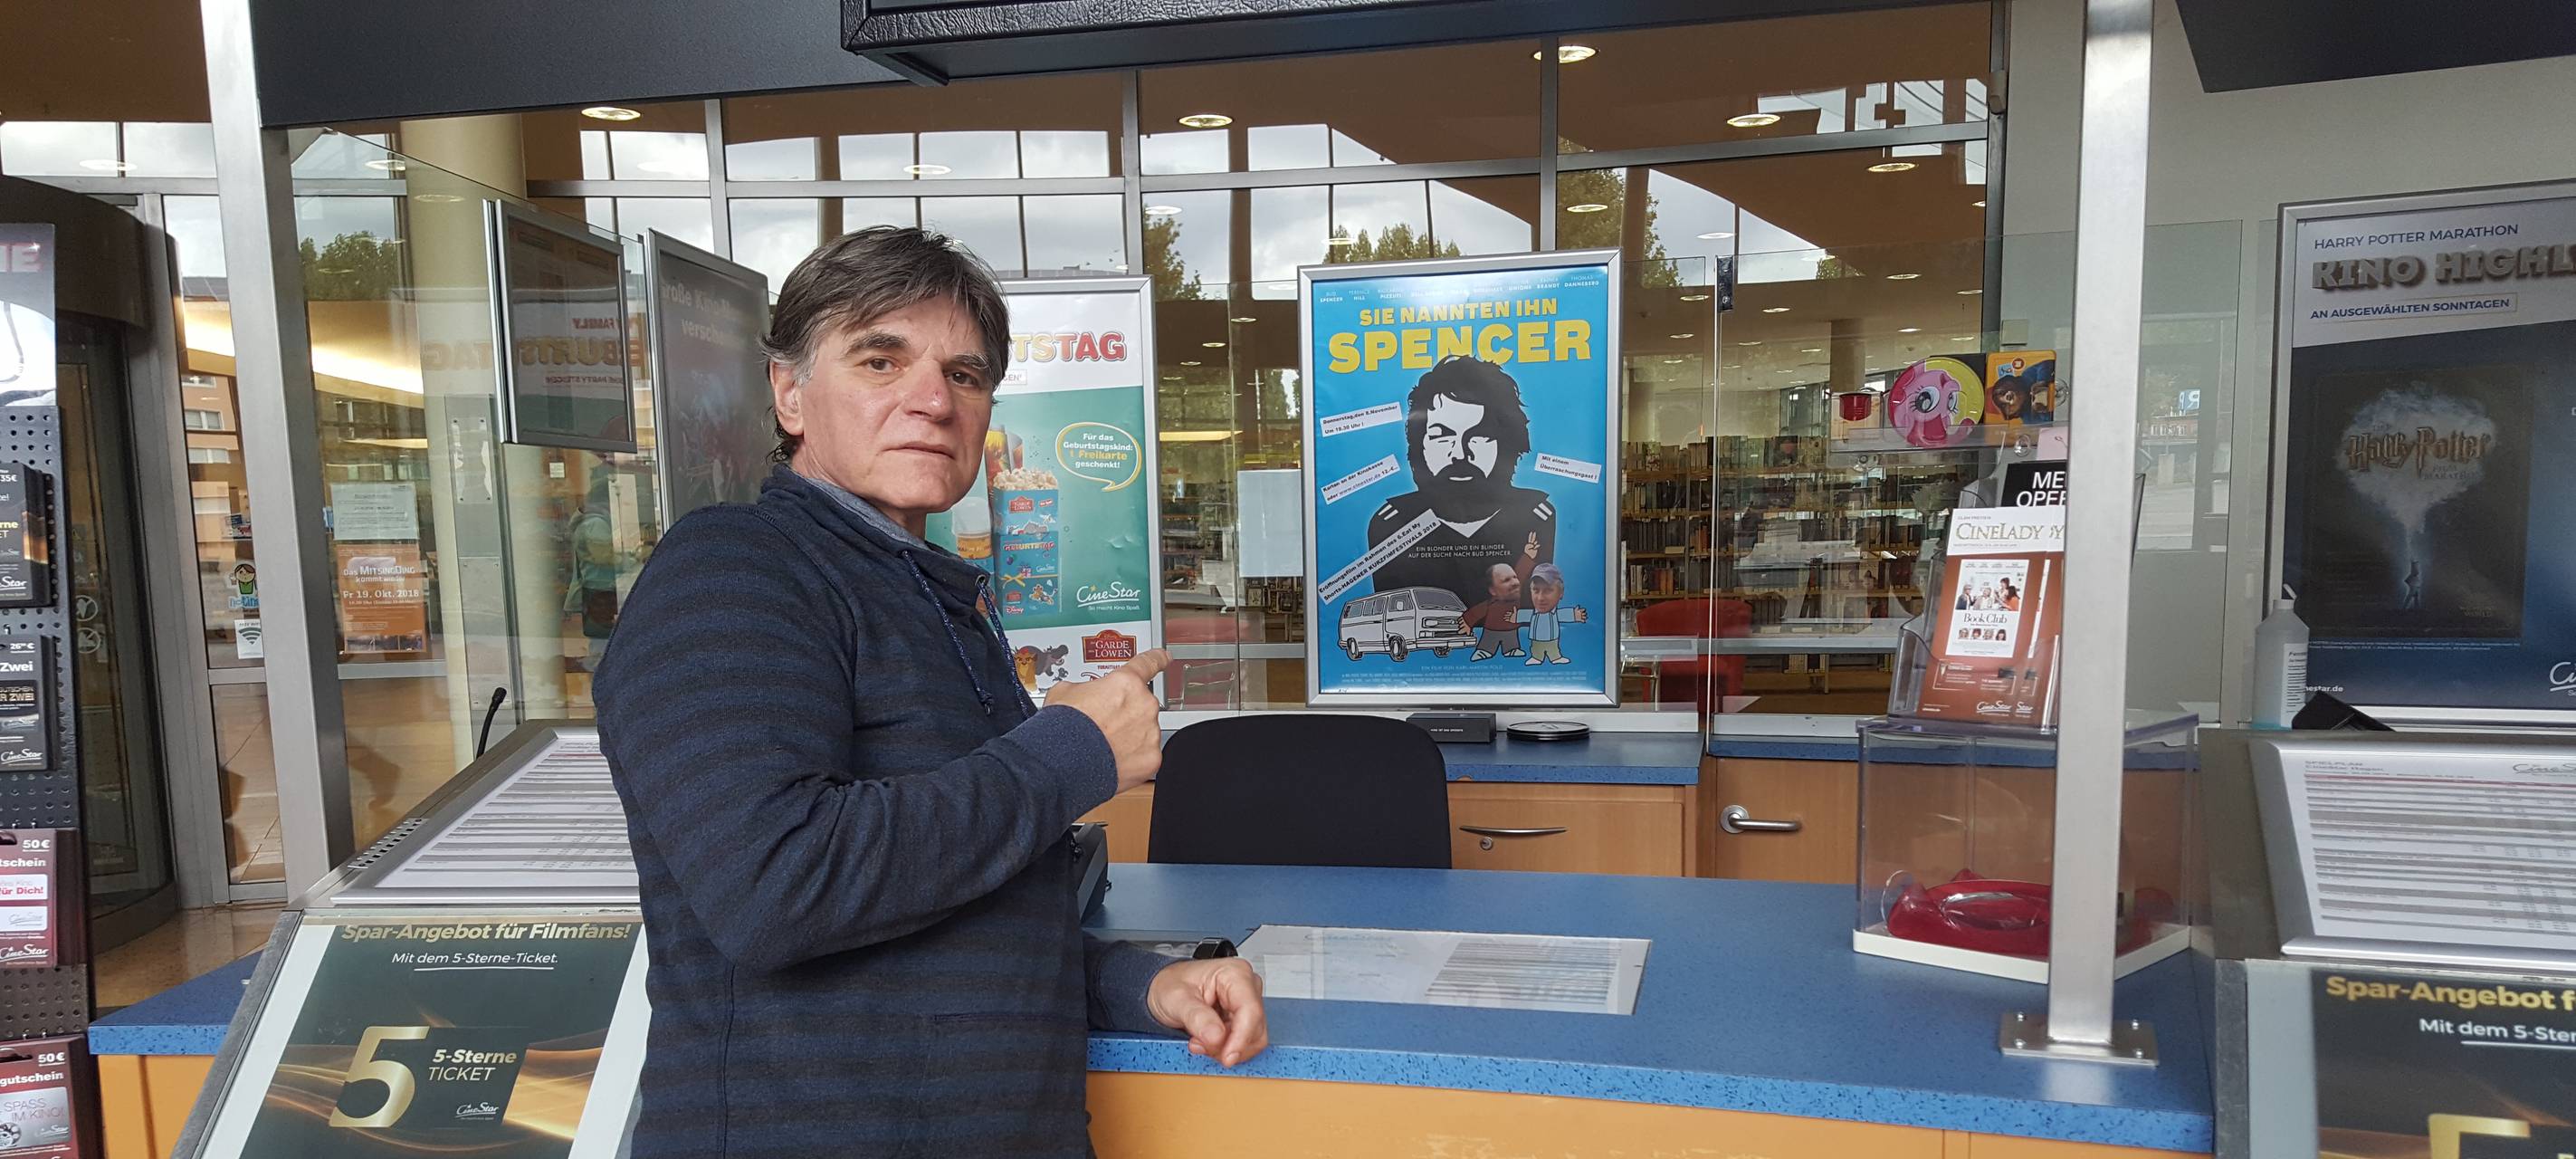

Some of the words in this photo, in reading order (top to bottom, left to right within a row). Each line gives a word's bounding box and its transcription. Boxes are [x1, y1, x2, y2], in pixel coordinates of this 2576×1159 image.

[2314, 236, 2364, 249] HARRY
[2369, 232, 2425, 245] POTTER
[2429, 225, 2519, 241] MARATHON
[2313, 255, 2425, 290] KINO
[2436, 243, 2576, 283] HIGHL
[1360, 307, 1395, 327] SIE
[1399, 301, 1511, 324] NANNTEN
[1516, 297, 1559, 316] IHN
[2310, 310, 2328, 319] AN
[2331, 303, 2430, 318] AUSGEWÄHLTEN
[2432, 298, 2510, 312] SONNTAGEN
[1328, 319, 1592, 374] SPENCER
[1083, 433, 1097, 441] Für
[1063, 440, 1133, 452] Geburtstagskind:
[1078, 449, 1129, 460] Freikarte
[1075, 460, 1121, 469] geschenkt!
[2032, 471, 2066, 489] ME
[1423, 522, 1437, 533] 2018
[1364, 546, 1387, 562] Rahmen
[1387, 538, 1397, 547] des
[1412, 522, 1421, 530] My
[343, 590, 353, 599] Fr
[375, 589, 395, 598] Okt.
[397, 589, 419, 598] 2018
[1076, 581, 1140, 604] CineStar
[1963, 613, 1985, 623] Book
[1986, 613, 2008, 623] Club
[1095, 639, 1130, 649] GARDE
[0, 661, 33, 672] Zwei
[9, 693, 34, 701] ZWEI
[16, 886, 44, 895] Dich!
[341, 924, 493, 943] Spar-Angebot
[495, 923, 528, 940] für
[531, 922, 632, 940] Filmfans!
[391, 953, 415, 964] Mit
[416, 953, 449, 964] dem
[452, 953, 558, 964] 5-Sterne-Ticket.
[2326, 976, 2556, 1010] Spar-Angebot
[2419, 1018, 2454, 1034] Mit
[2458, 1020, 2508, 1039] dem
[432, 1049, 518, 1064] 5-Sterne
[329, 1025, 432, 1128] 5
[428, 1067, 496, 1081] TICKET
[4, 1098, 46, 1112] SPASS
[455, 1101, 499, 1116] CineStar
[12, 1112, 25, 1122] IM
